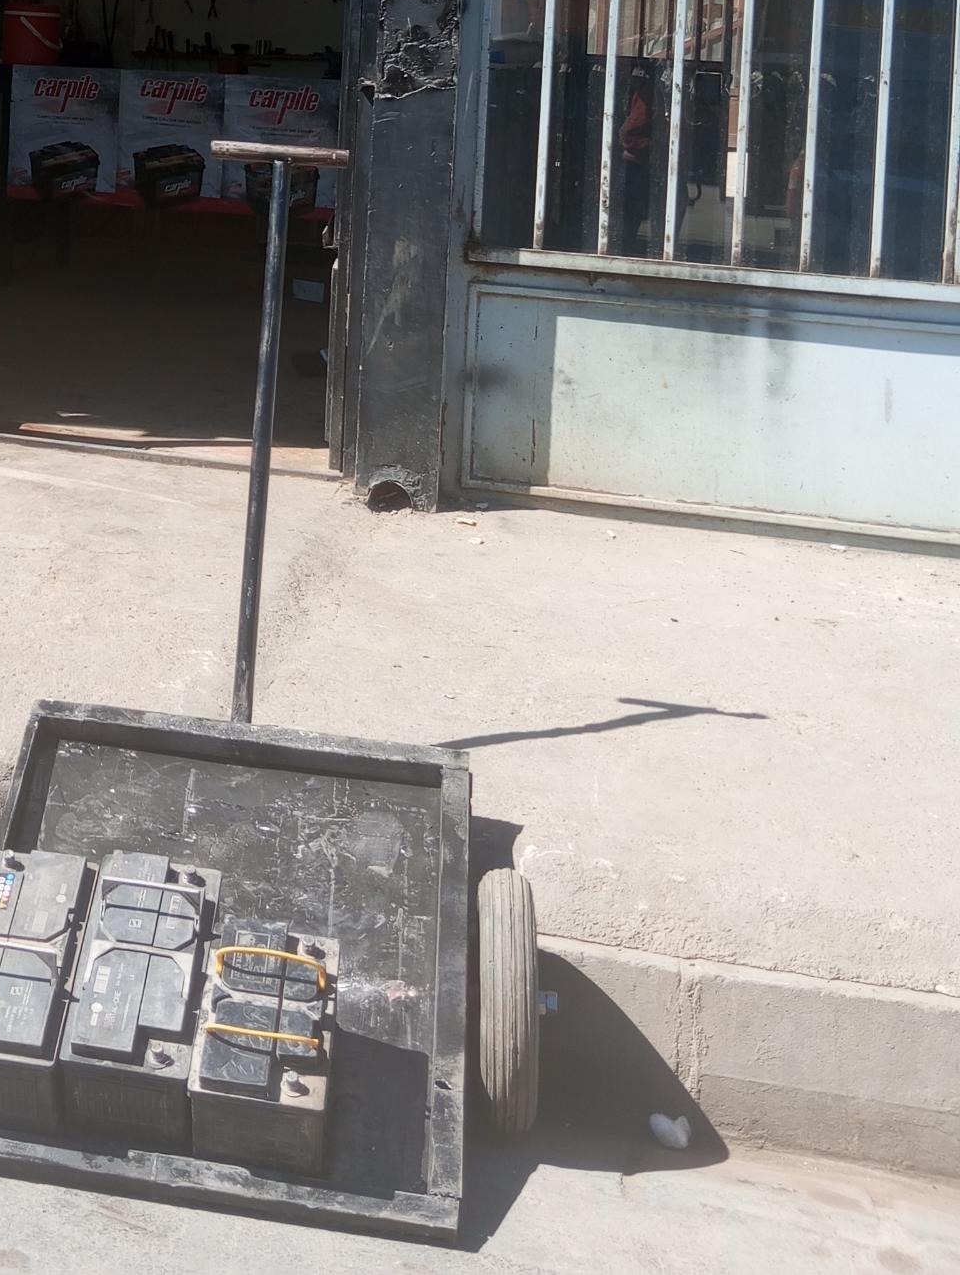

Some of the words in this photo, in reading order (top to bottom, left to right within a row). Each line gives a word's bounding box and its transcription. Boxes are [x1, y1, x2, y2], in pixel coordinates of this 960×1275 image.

[33, 75, 100, 113] carpile
[140, 76, 208, 115] carpile
[249, 85, 320, 125] carpile
